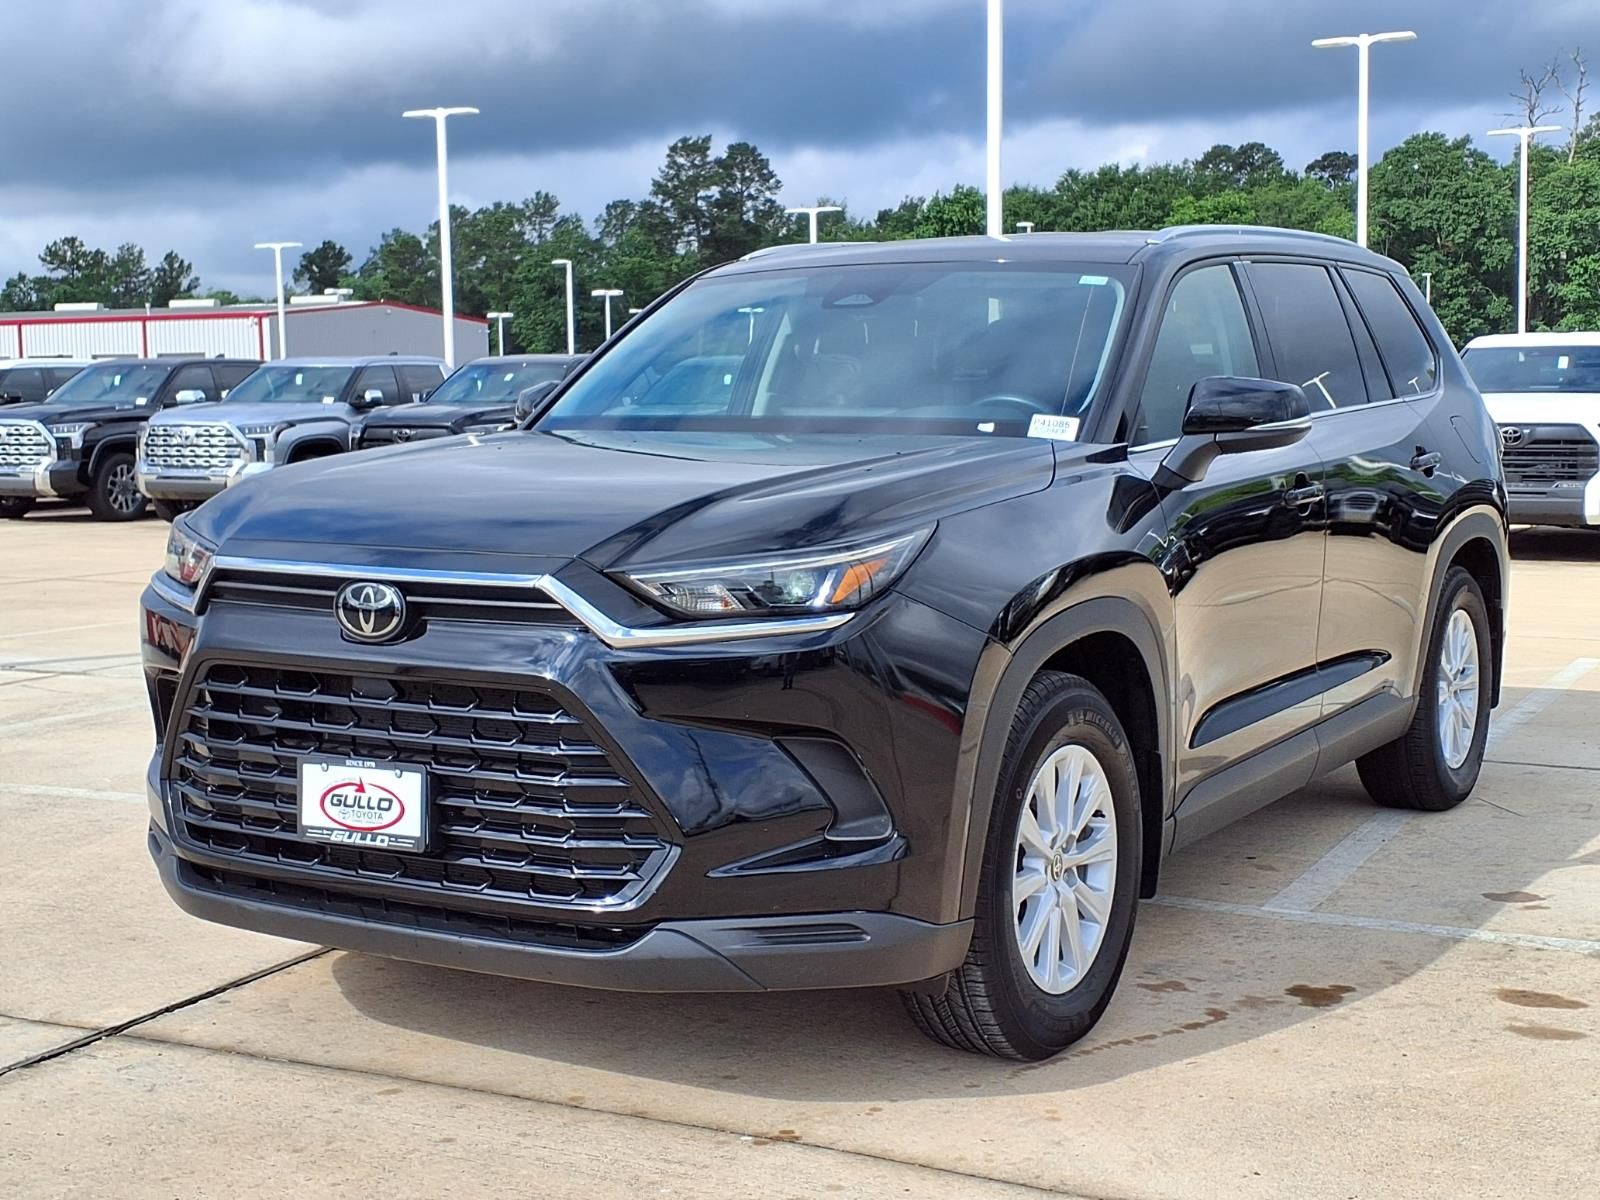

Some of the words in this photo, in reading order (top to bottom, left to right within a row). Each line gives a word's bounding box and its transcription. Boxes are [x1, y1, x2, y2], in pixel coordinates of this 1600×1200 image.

[1085, 711, 1121, 748] MICHELIN
[330, 793, 393, 812] GULLO
[351, 809, 384, 821] TOYOTA
[330, 830, 389, 847] GULLO
